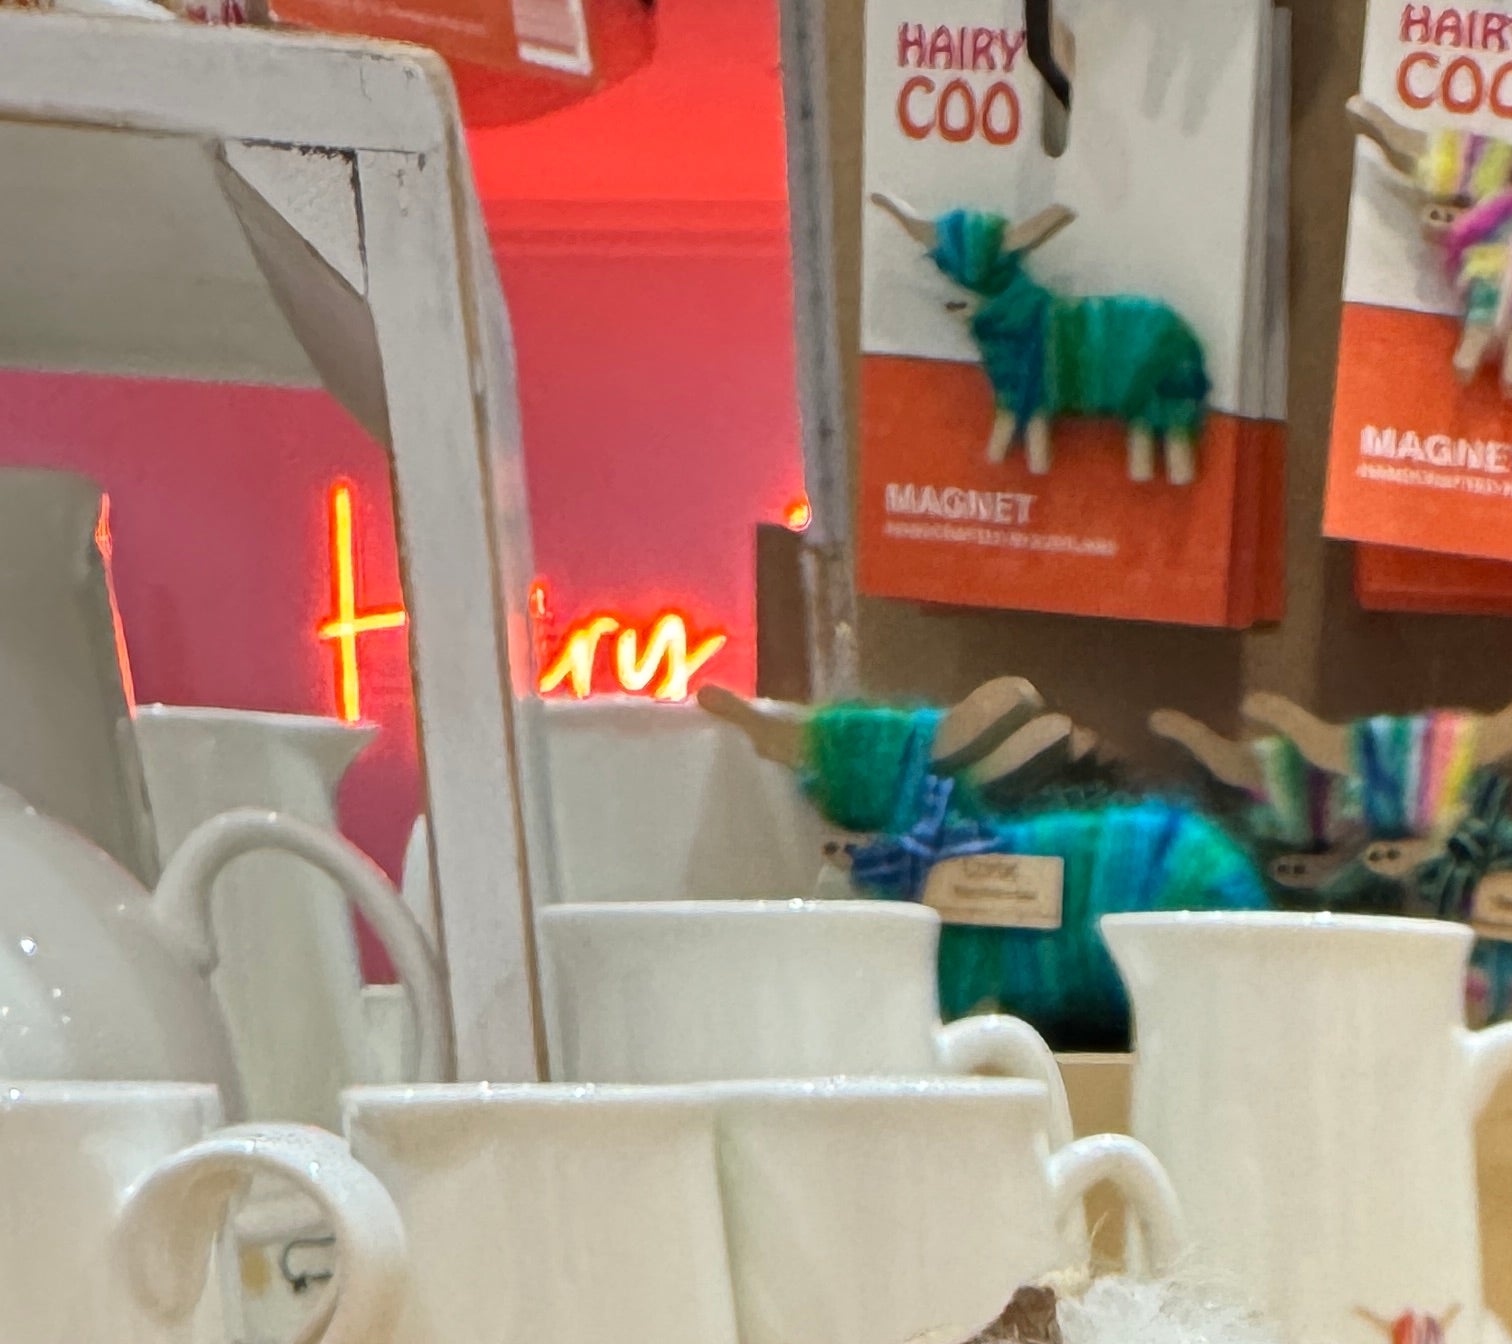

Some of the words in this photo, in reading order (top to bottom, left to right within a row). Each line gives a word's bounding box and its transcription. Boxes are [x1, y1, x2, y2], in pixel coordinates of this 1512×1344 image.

[900, 22, 1025, 70] HAIRY
[898, 76, 1021, 145] COO
[885, 482, 1038, 525] MAGNET
